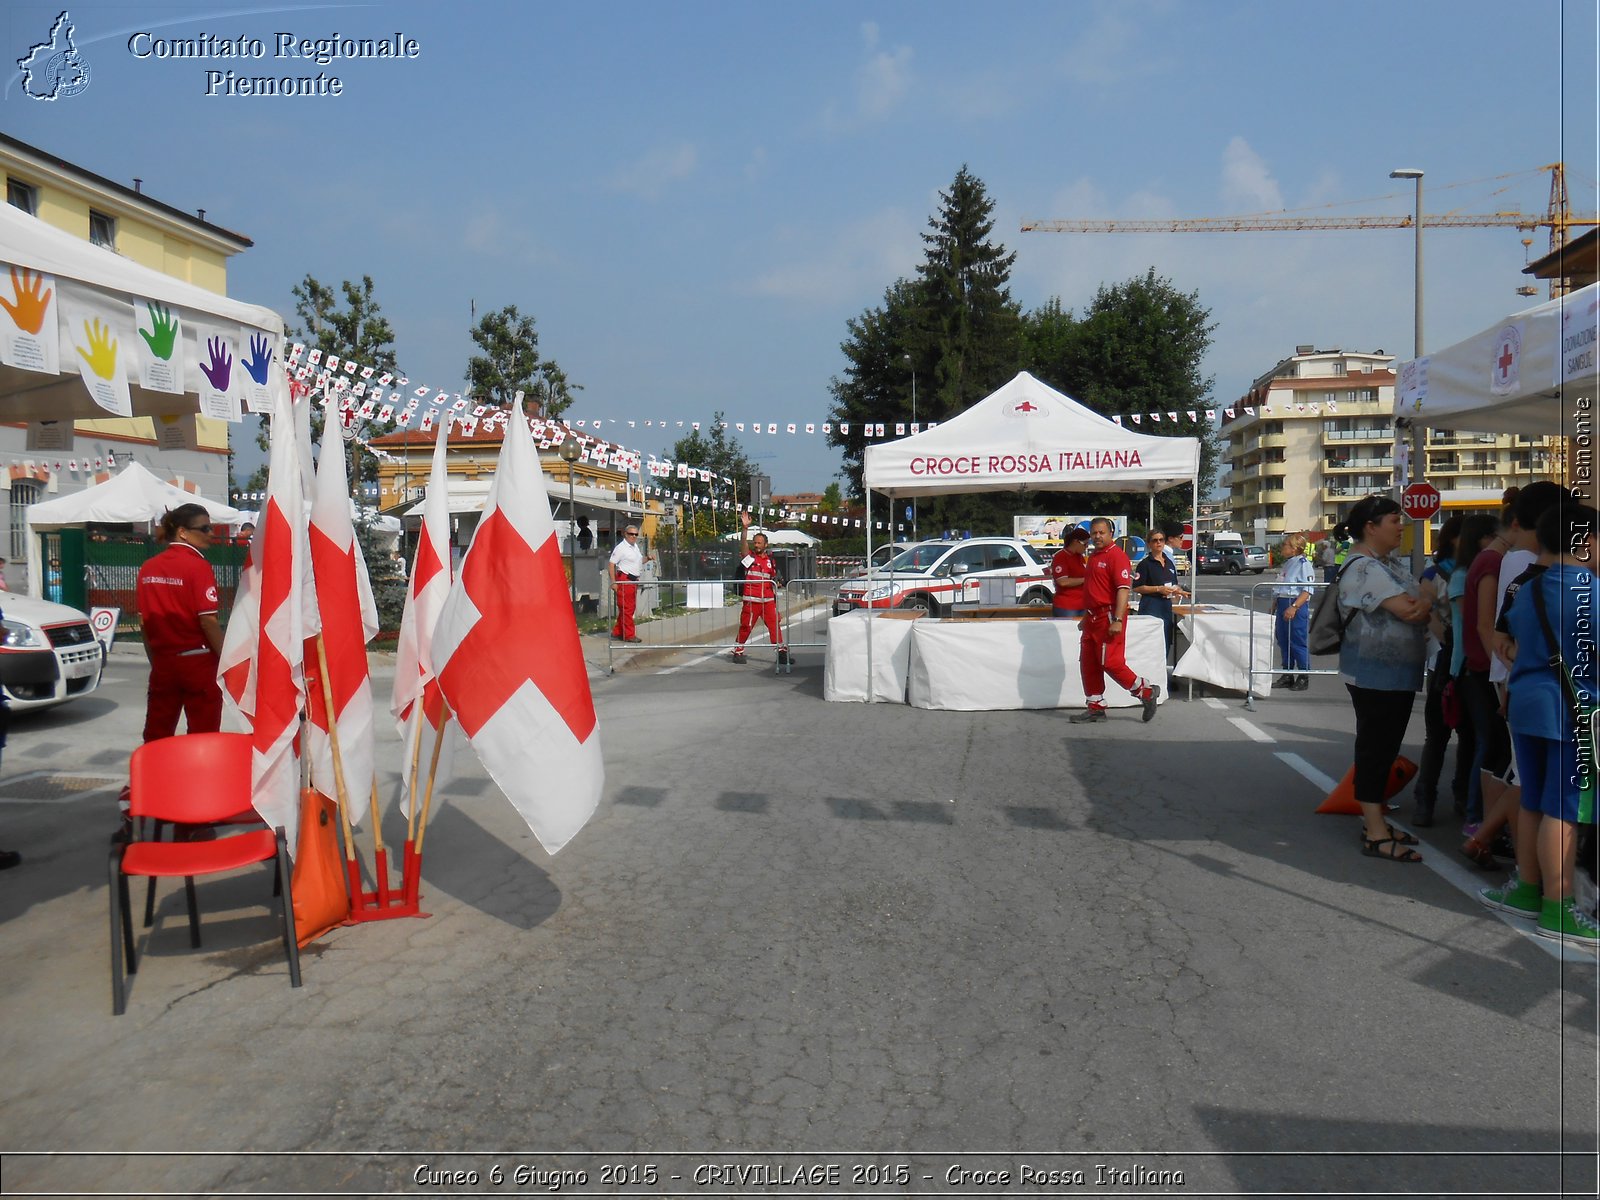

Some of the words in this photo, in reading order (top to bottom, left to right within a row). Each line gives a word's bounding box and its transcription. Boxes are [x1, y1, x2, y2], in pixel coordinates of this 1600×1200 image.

[1567, 351, 1593, 374] SANGUE
[910, 456, 980, 475] CROCE
[988, 453, 1052, 473] ROSSA
[1058, 449, 1143, 471] ITALIANA
[1404, 494, 1438, 508] STOP
[98, 617, 109, 626] 10
